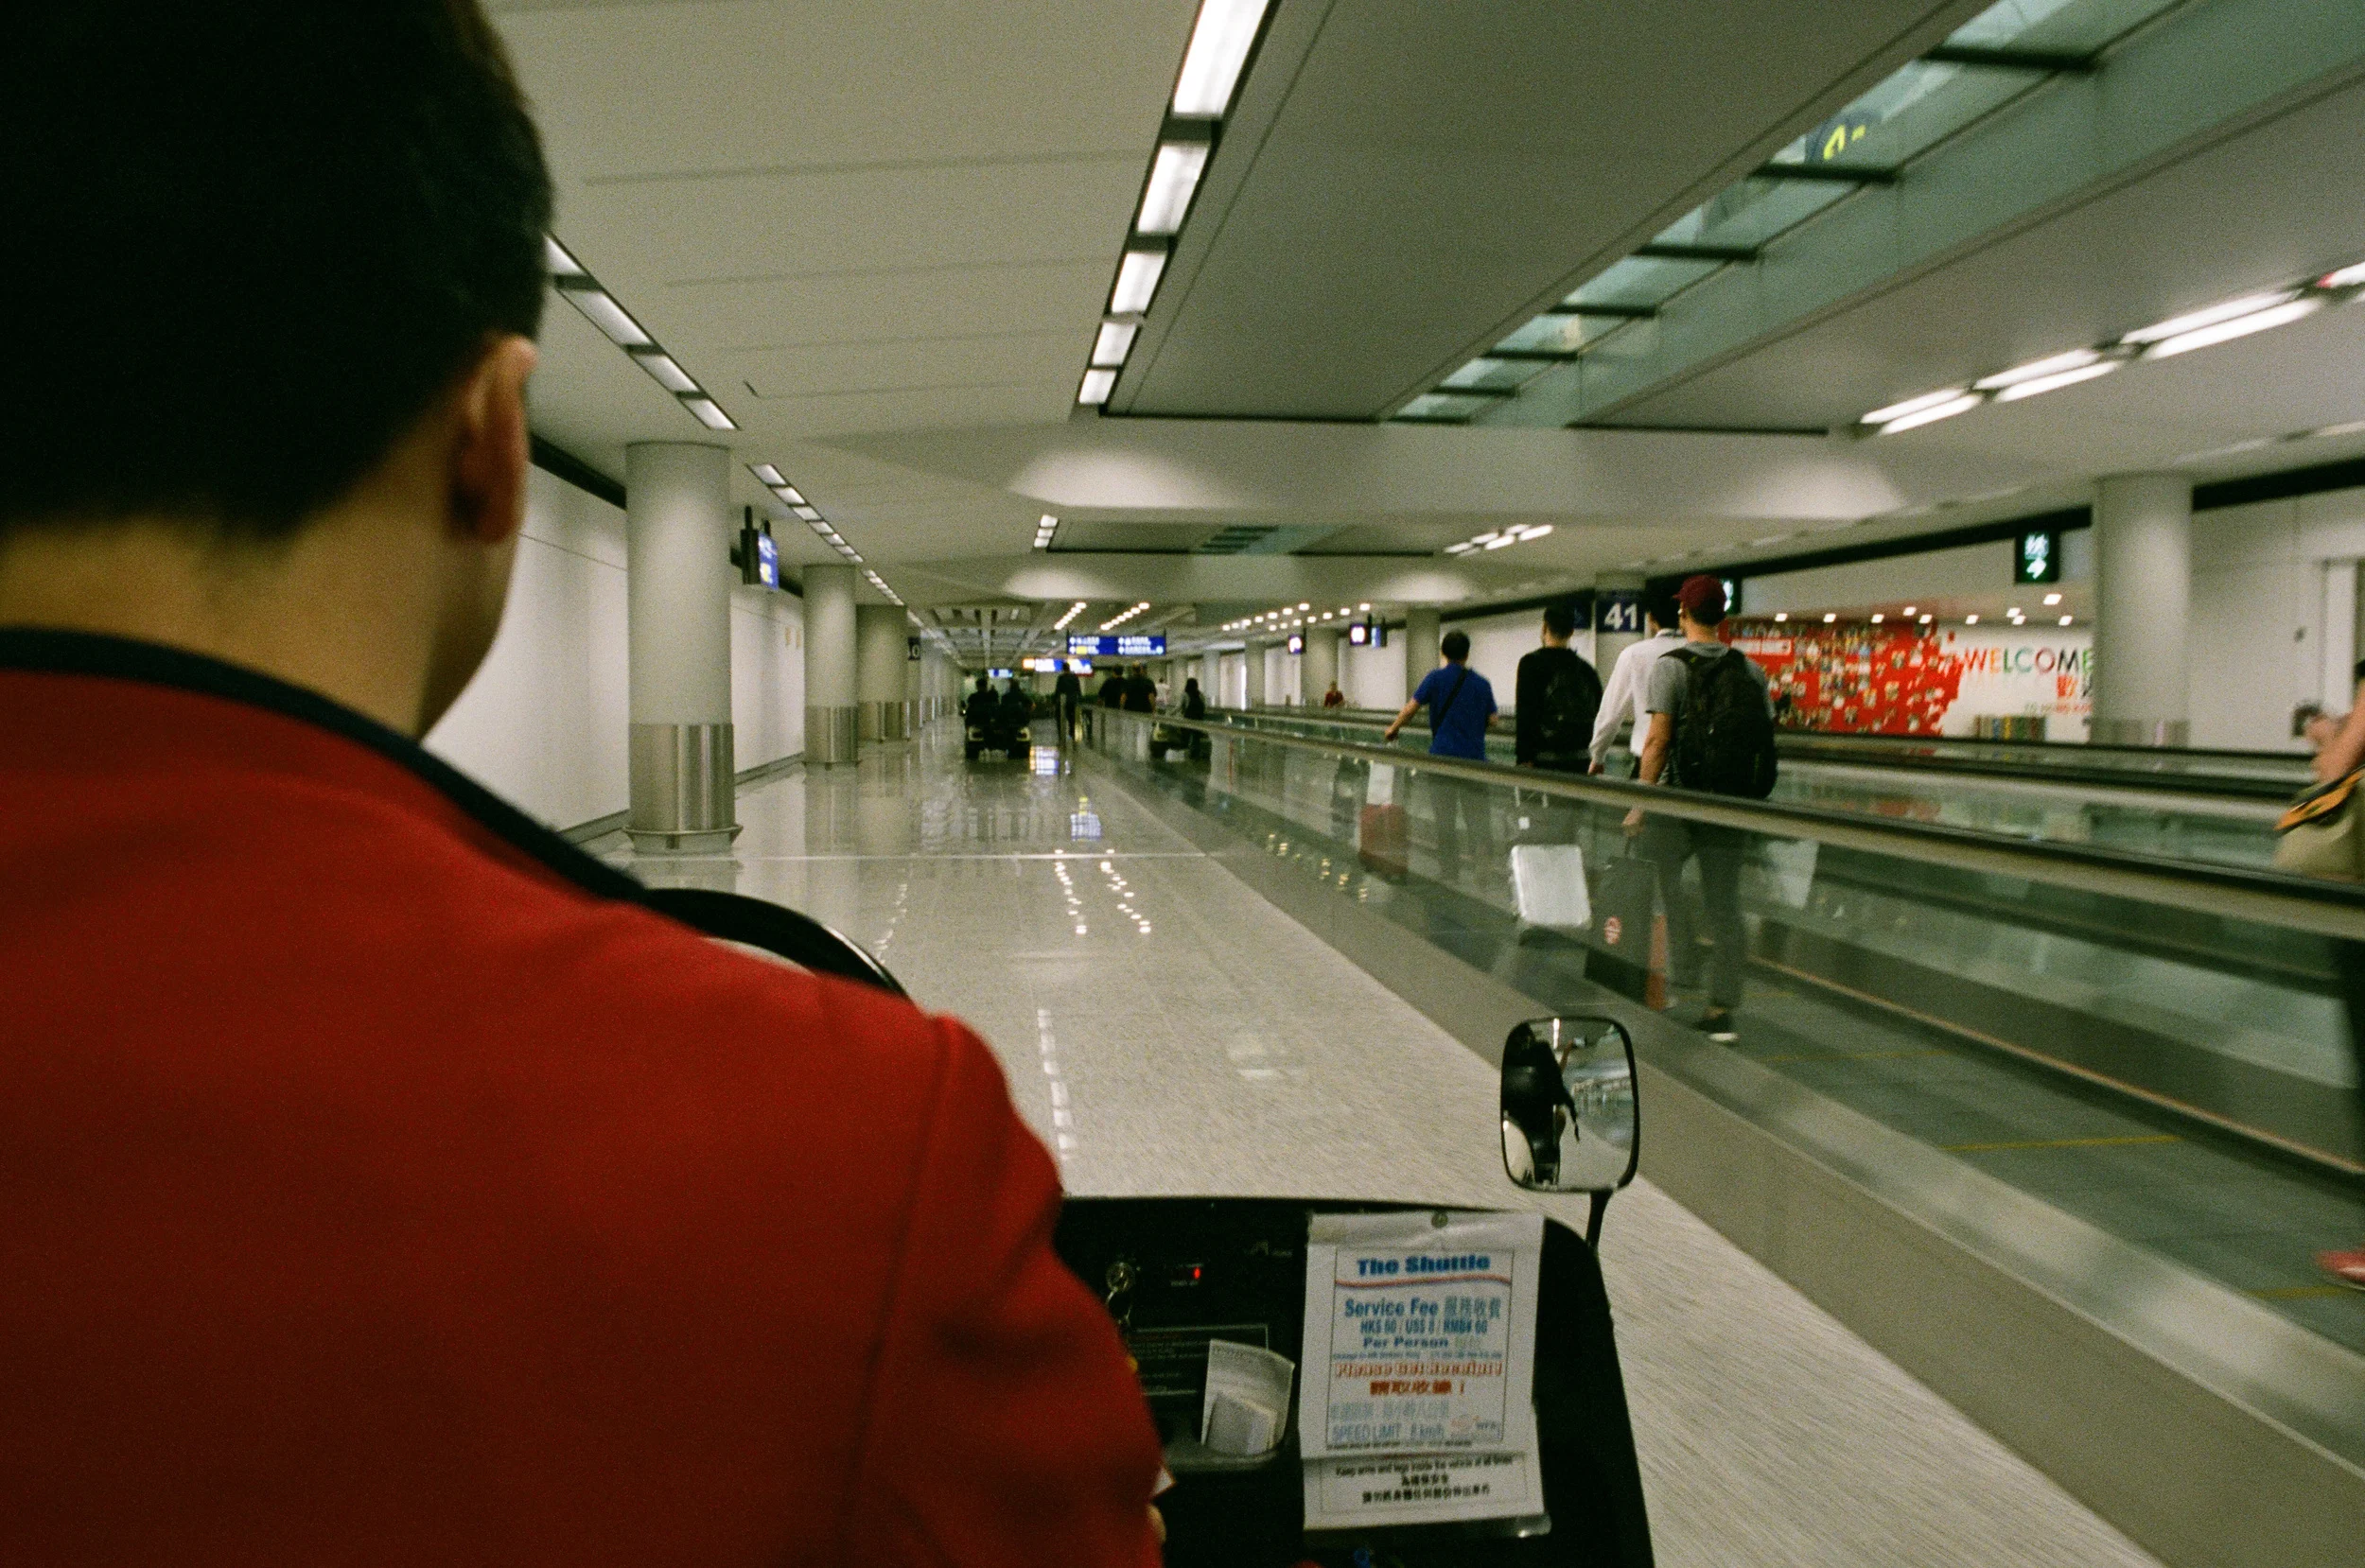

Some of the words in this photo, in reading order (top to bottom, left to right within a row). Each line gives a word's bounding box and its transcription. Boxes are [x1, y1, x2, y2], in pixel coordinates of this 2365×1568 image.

[1604, 601, 1638, 631] 41
[1357, 1258, 1400, 1276] The
[1405, 1253, 1492, 1273] Shuttle
[1344, 1297, 1405, 1317] Service
[1410, 1297, 1439, 1315] Fee
[1362, 1336, 1389, 1350] Per
[1393, 1335, 1449, 1349] Person
